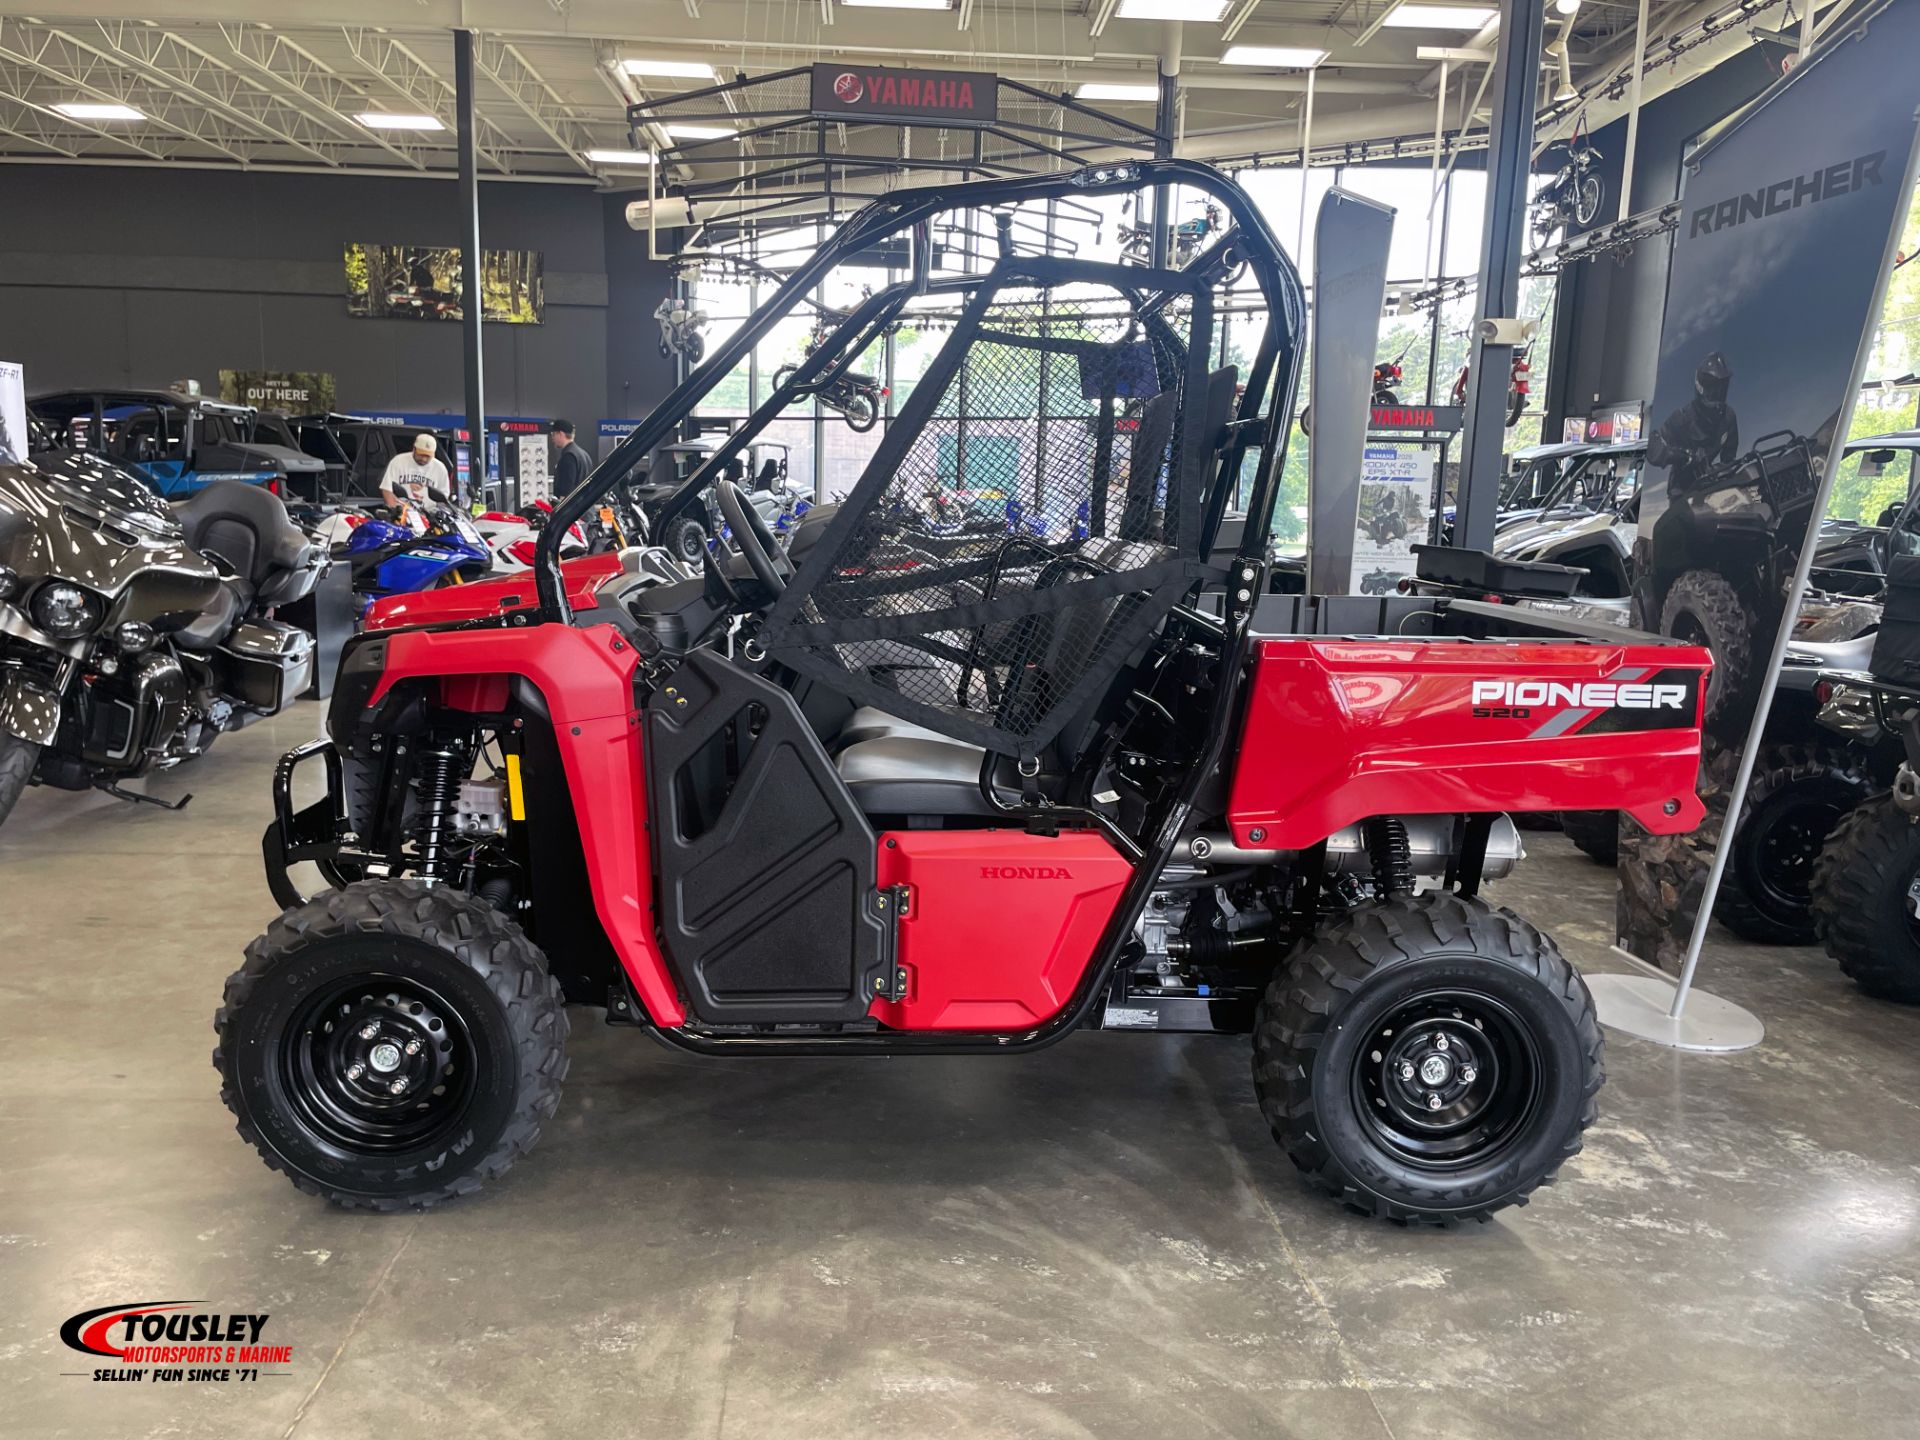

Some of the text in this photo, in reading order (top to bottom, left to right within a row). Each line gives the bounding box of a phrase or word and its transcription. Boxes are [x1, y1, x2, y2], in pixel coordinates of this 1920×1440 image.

[866, 75, 974, 109] YAMAHA
[1688, 149, 1887, 239] RANCHER
[247, 388, 309, 401] OUT HERE
[363, 417, 404, 425] LARIS
[1371, 408, 1434, 427] YAMAHA
[508, 423, 539, 431] YAMAHA
[1399, 462, 1418, 470] 450
[1472, 681, 1687, 709] PIONEER
[1472, 708, 1530, 719] 520
[979, 866, 1075, 880] HONDA
